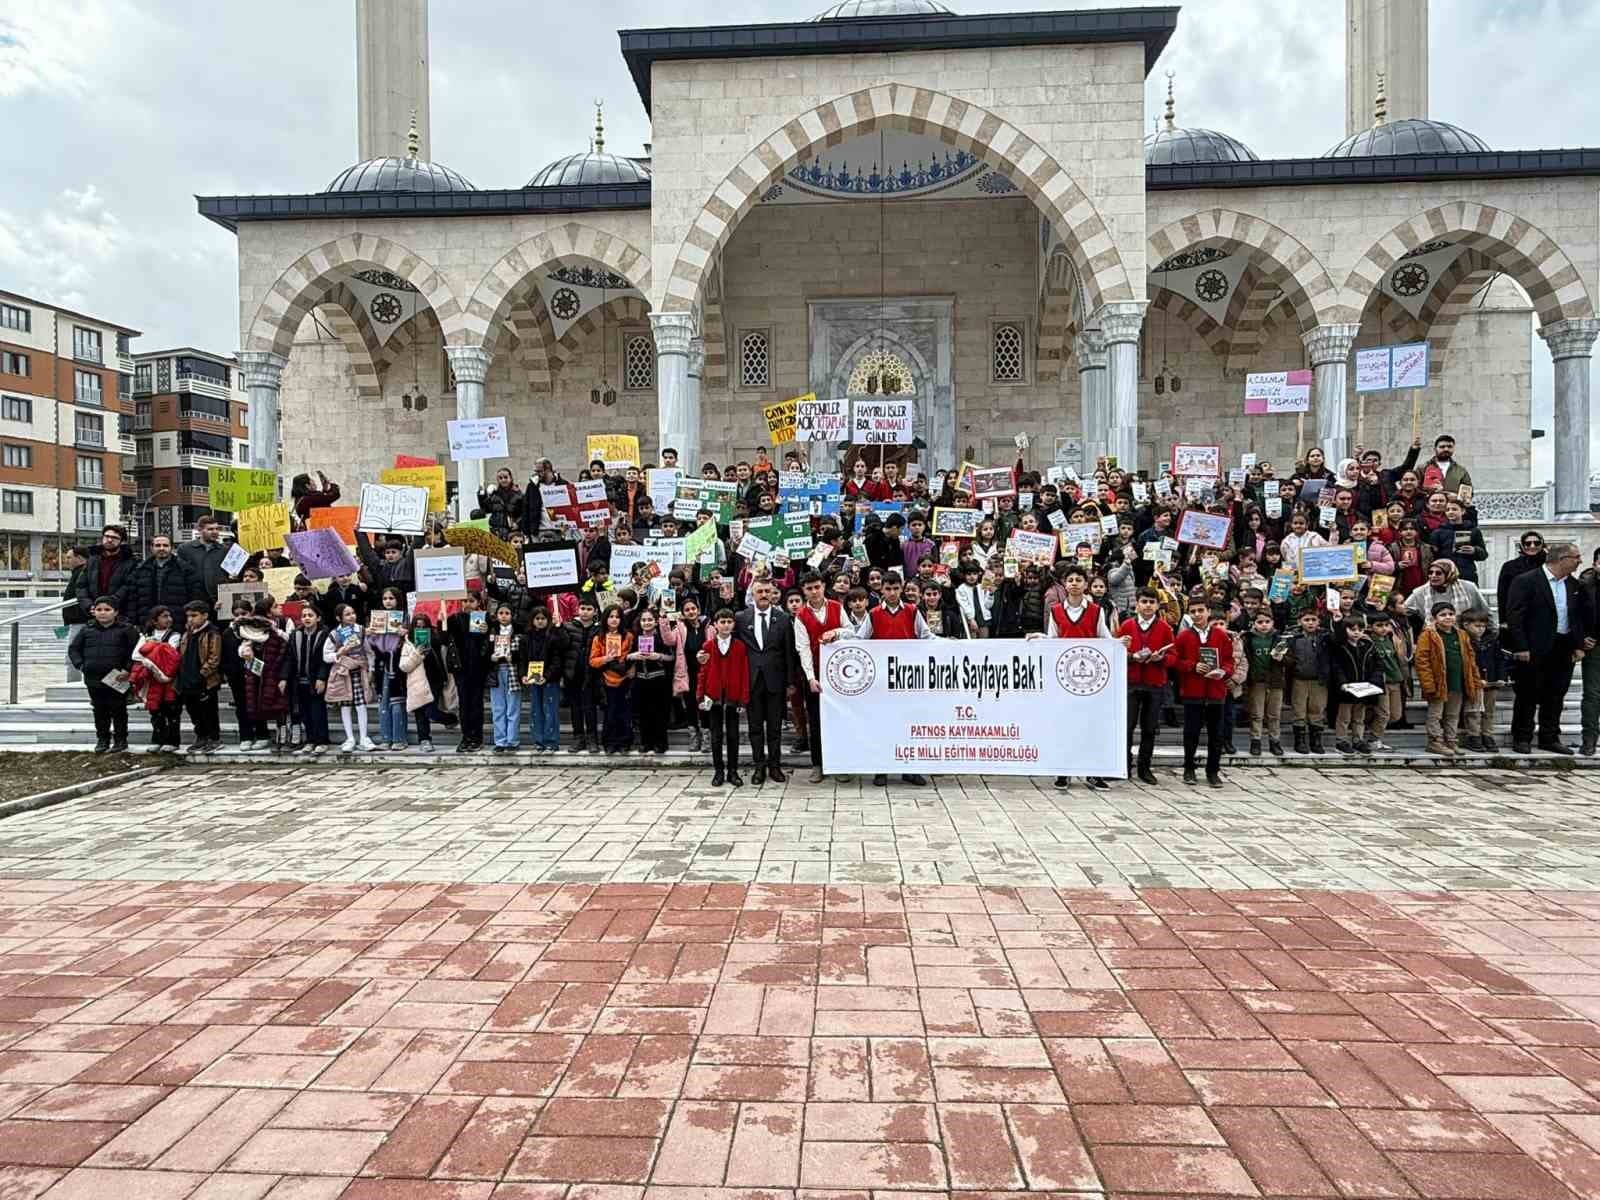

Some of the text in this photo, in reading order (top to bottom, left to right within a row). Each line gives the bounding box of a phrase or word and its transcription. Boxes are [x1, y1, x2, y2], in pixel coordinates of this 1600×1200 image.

[856, 418, 871, 430] BOL
[887, 655, 925, 690] Ekranı
[928, 655, 960, 690] Bırak
[962, 655, 1009, 699] Sayfaya
[1012, 655, 1036, 690] Bak
[955, 706, 977, 718] T.C.
[910, 723, 1020, 737] PATNOS KAYMAKAMLIĞI
[895, 744, 1039, 760] İLÇE MİLLİ EĞİTİM MÜDÜRLÜĞÜ
